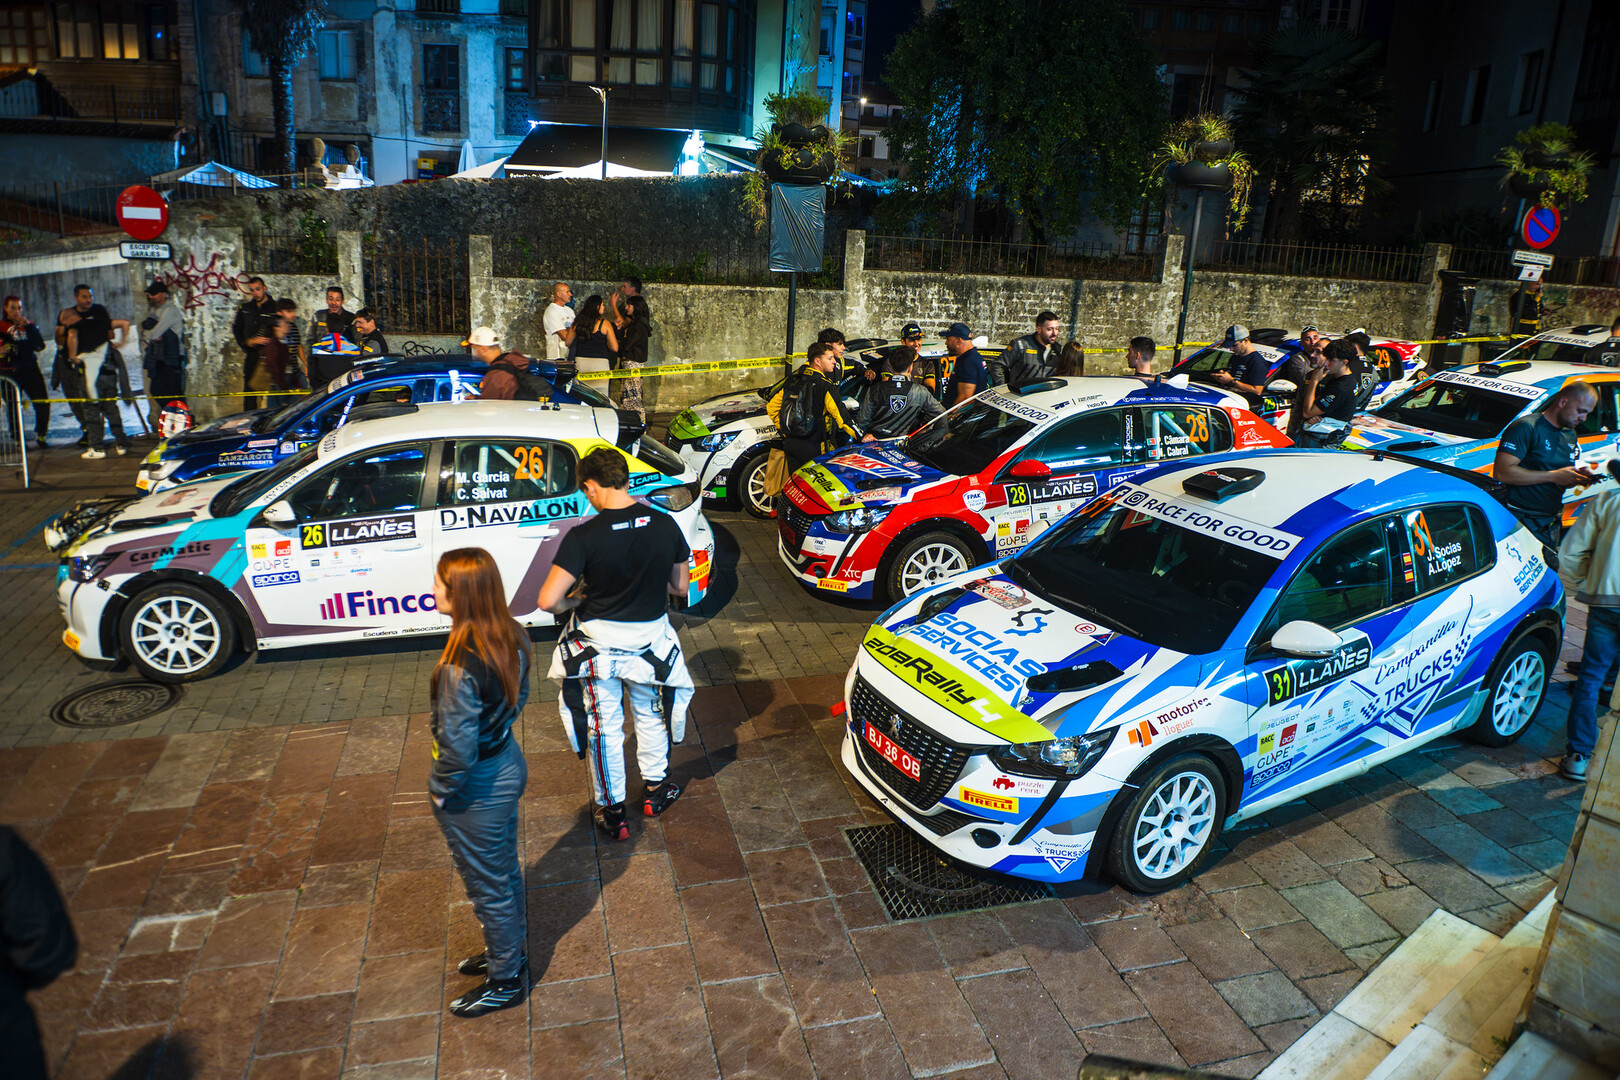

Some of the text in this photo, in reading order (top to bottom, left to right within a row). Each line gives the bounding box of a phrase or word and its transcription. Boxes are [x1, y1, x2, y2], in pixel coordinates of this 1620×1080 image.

[940, 356, 957, 378] 27
[1375, 349, 1391, 368] 29
[1456, 375, 1539, 396] RACE FOR GOOD
[1003, 400, 1017, 412] FOR
[1016, 406, 1049, 421] GOOD
[1185, 414, 1209, 442] 28
[1164, 435, 1190, 445] Câmara
[1167, 445, 1189, 456] Cabral
[218, 453, 273, 462] LANZAROTE
[513, 446, 544, 480] 26
[456, 471, 471, 484] M.
[457, 487, 508, 500] C. Salvat
[1010, 486, 1027, 505] 28
[1032, 480, 1095, 500] LLANES
[302, 520, 414, 547] 26 LLANES
[1142, 499, 1291, 551] RACE FOR GOOD
[1413, 511, 1436, 557] 31
[129, 542, 212, 563] CarMatic
[1434, 541, 1463, 559] Socias
[254, 572, 298, 584] sparco
[1513, 554, 1540, 587] SOCIAS
[1518, 562, 1545, 595] SERVICES
[819, 579, 846, 591] PIRELLI
[929, 612, 1050, 681] SOCIAS
[908, 625, 1022, 693] SERVICES
[1273, 670, 1292, 701] 31
[1298, 647, 1370, 688] LLANES
[1384, 648, 1454, 707] TRUCKS
[1163, 717, 1194, 737] lloguer
[1265, 712, 1300, 730] PEUGEOT
[1260, 732, 1275, 745] RACC
[869, 726, 882, 748] BJ
[885, 741, 898, 761] 36
[902, 754, 920, 778] OB
[1252, 760, 1292, 785] sparco
[1017, 780, 1046, 791] puzzle
[1019, 785, 1041, 795] rent
[963, 789, 1014, 811] PIRELLI
[1045, 848, 1078, 858] TRUCKS
